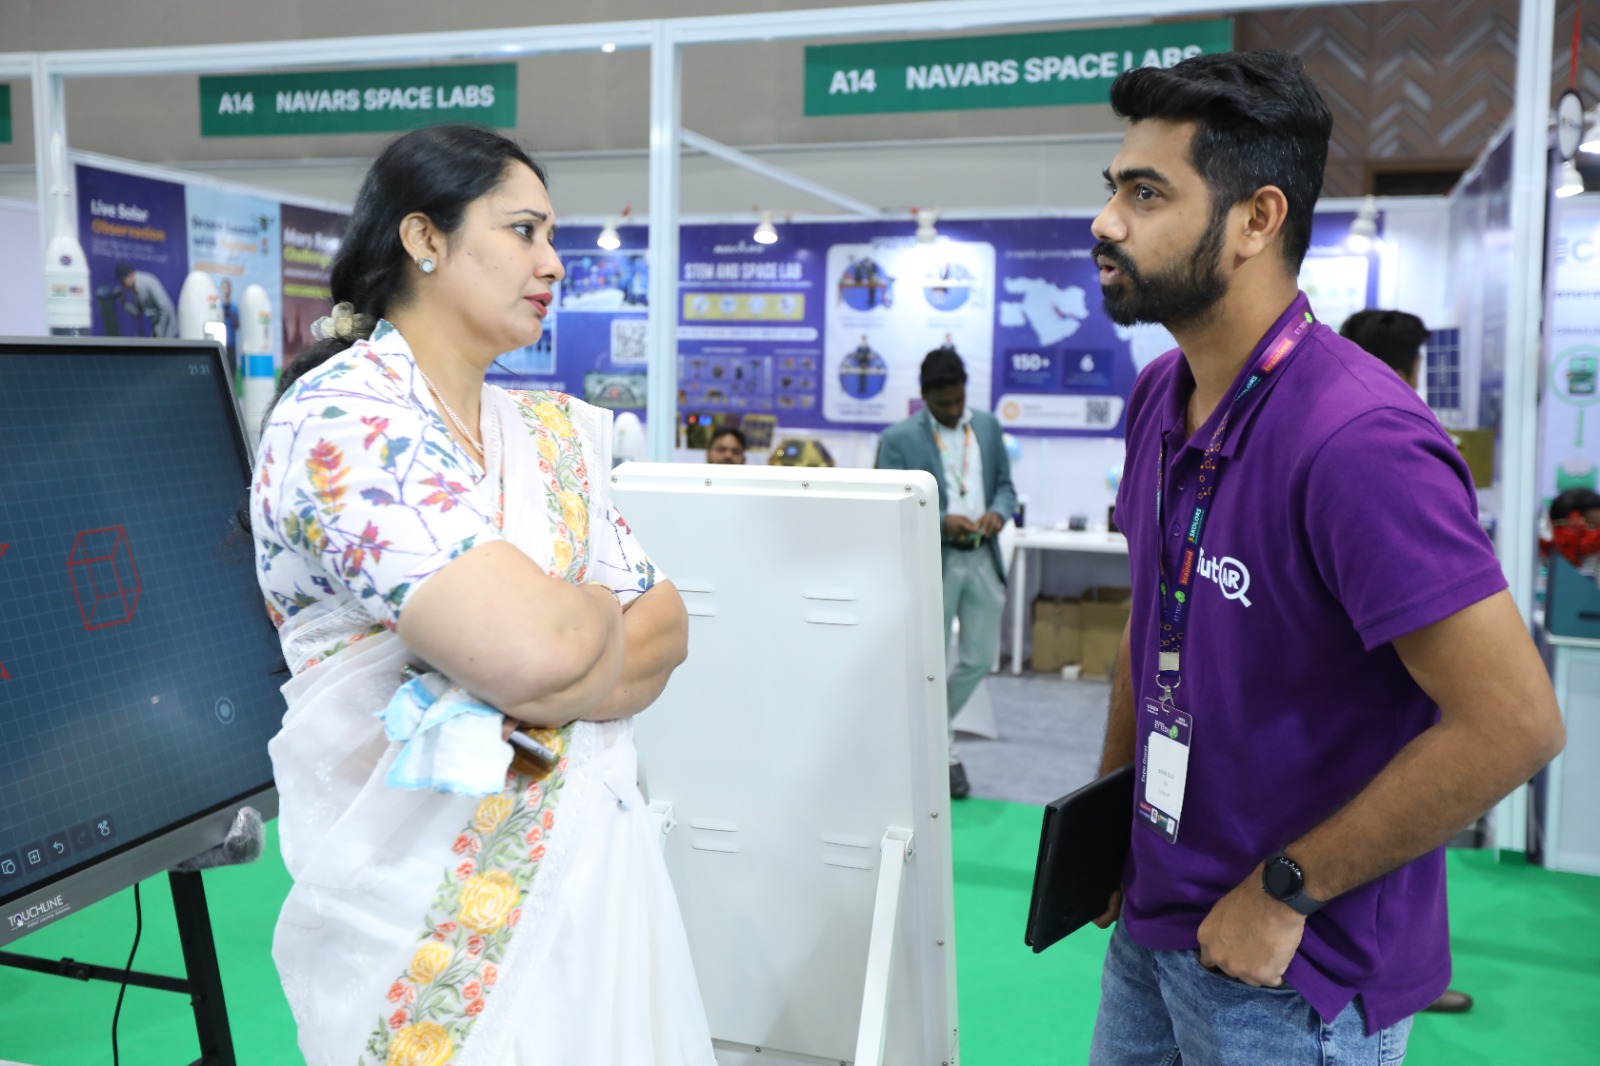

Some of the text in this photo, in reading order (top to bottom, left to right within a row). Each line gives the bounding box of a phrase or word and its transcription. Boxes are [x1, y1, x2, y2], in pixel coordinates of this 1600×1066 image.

[828, 68, 877, 95] A14
[905, 59, 1019, 91] NAVARS
[1023, 51, 1118, 85] SPACE
[218, 84, 495, 114] A14 NAVARS SPACE LABS
[90, 198, 149, 222] Live Solar
[741, 262, 777, 280] SPACE
[1011, 353, 1051, 372] 150+
[1079, 353, 1095, 373] 6
[1189, 507, 1202, 538] SKOLORS
[8, 894, 64, 927] TOUCHLINE
